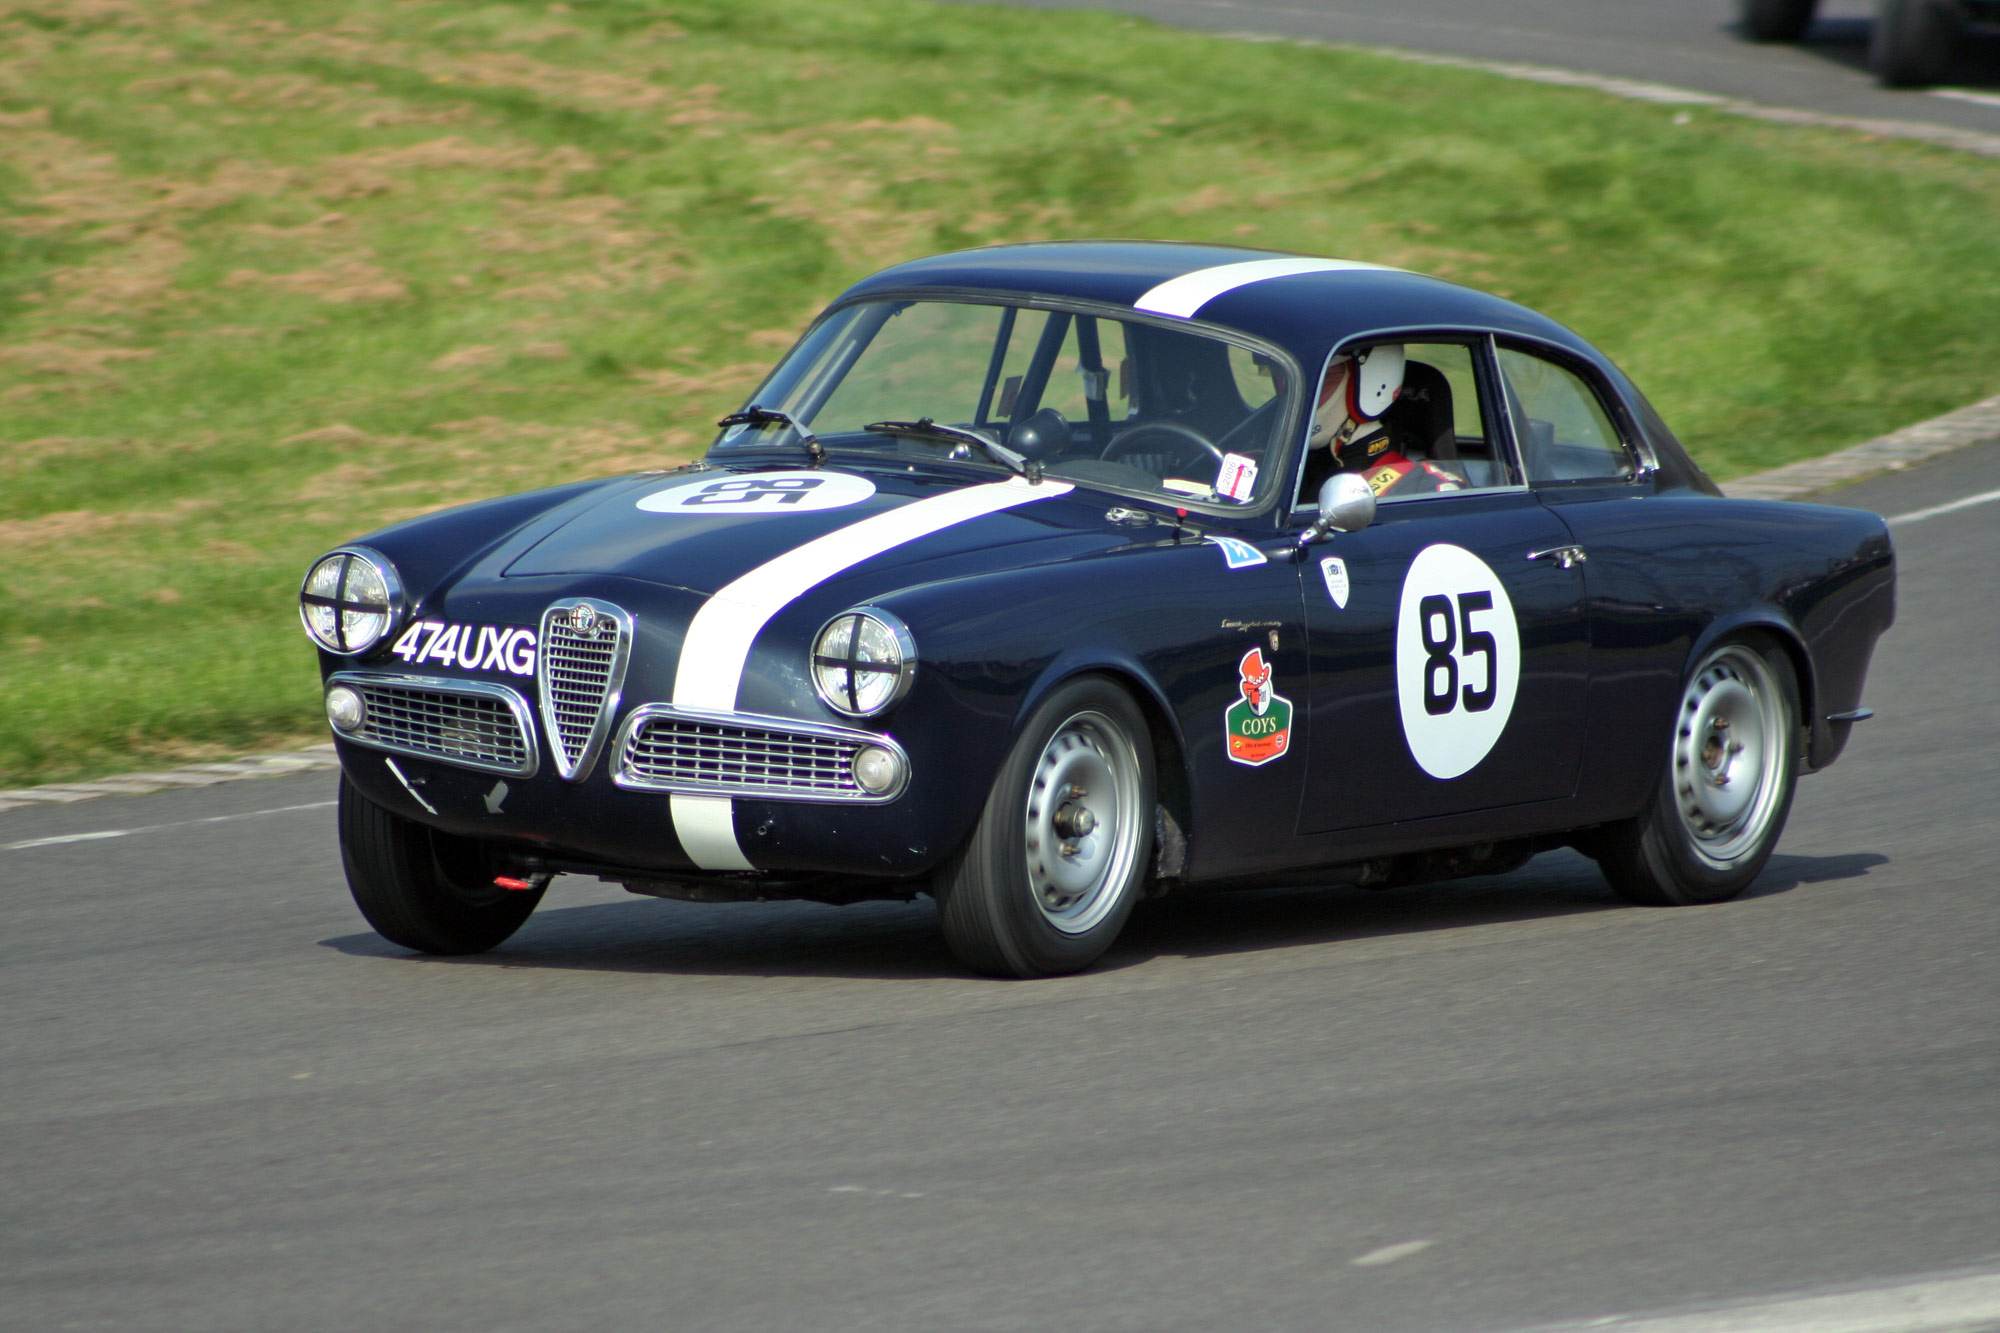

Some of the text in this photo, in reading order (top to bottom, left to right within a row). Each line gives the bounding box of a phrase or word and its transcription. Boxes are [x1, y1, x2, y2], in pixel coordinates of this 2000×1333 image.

[681, 478, 825, 505] 85
[391, 621, 537, 676] 474UXG
[1420, 590, 1497, 716] 85
[1242, 716, 1276, 735] COYS
